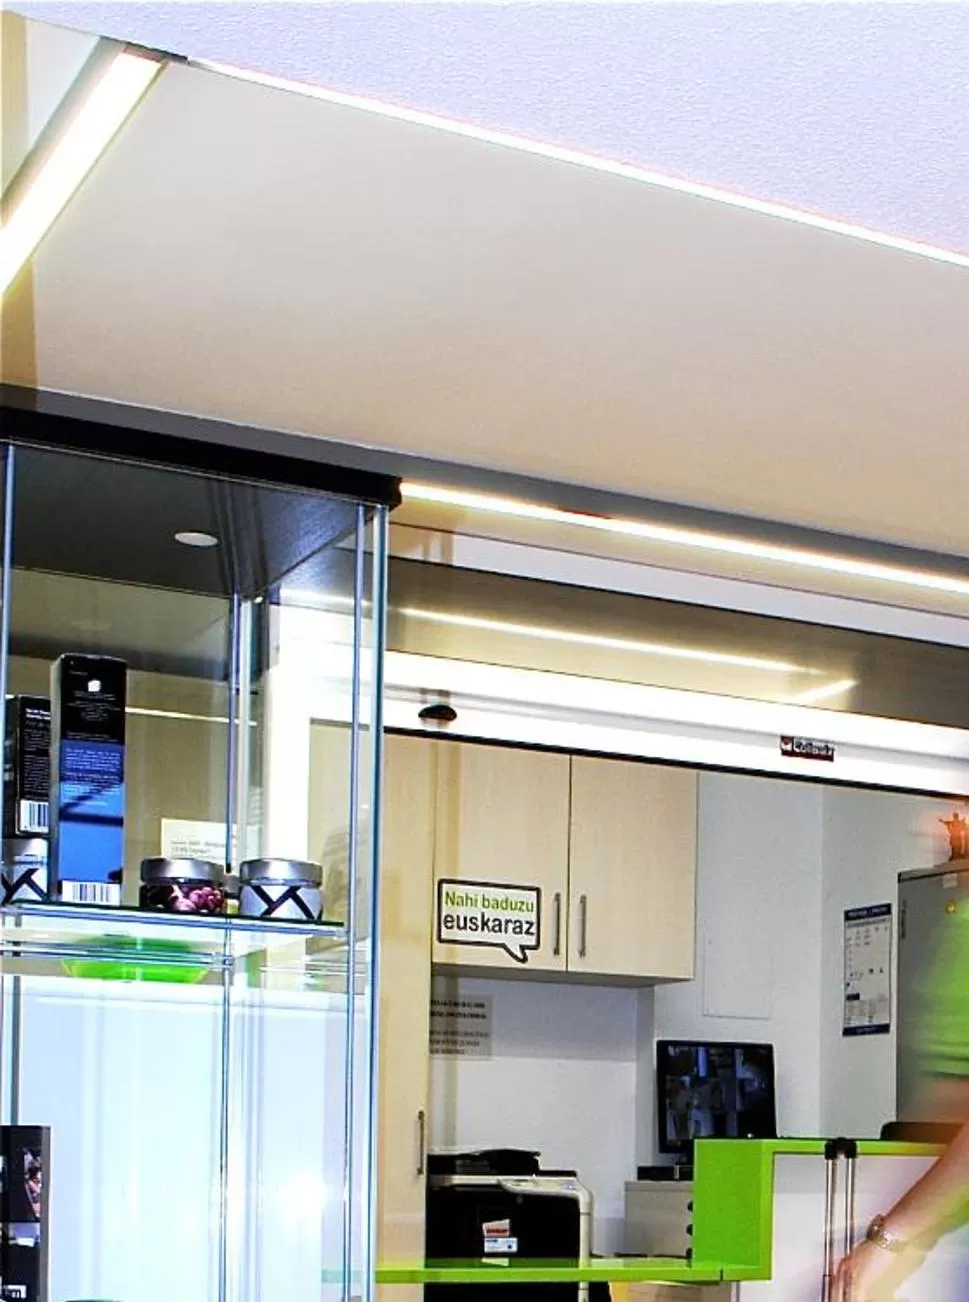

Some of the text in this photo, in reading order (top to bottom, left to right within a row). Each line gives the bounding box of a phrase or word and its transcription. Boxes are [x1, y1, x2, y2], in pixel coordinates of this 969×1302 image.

[445, 891, 534, 912] Nahi baduzu
[443, 912, 535, 935] euskaraz
